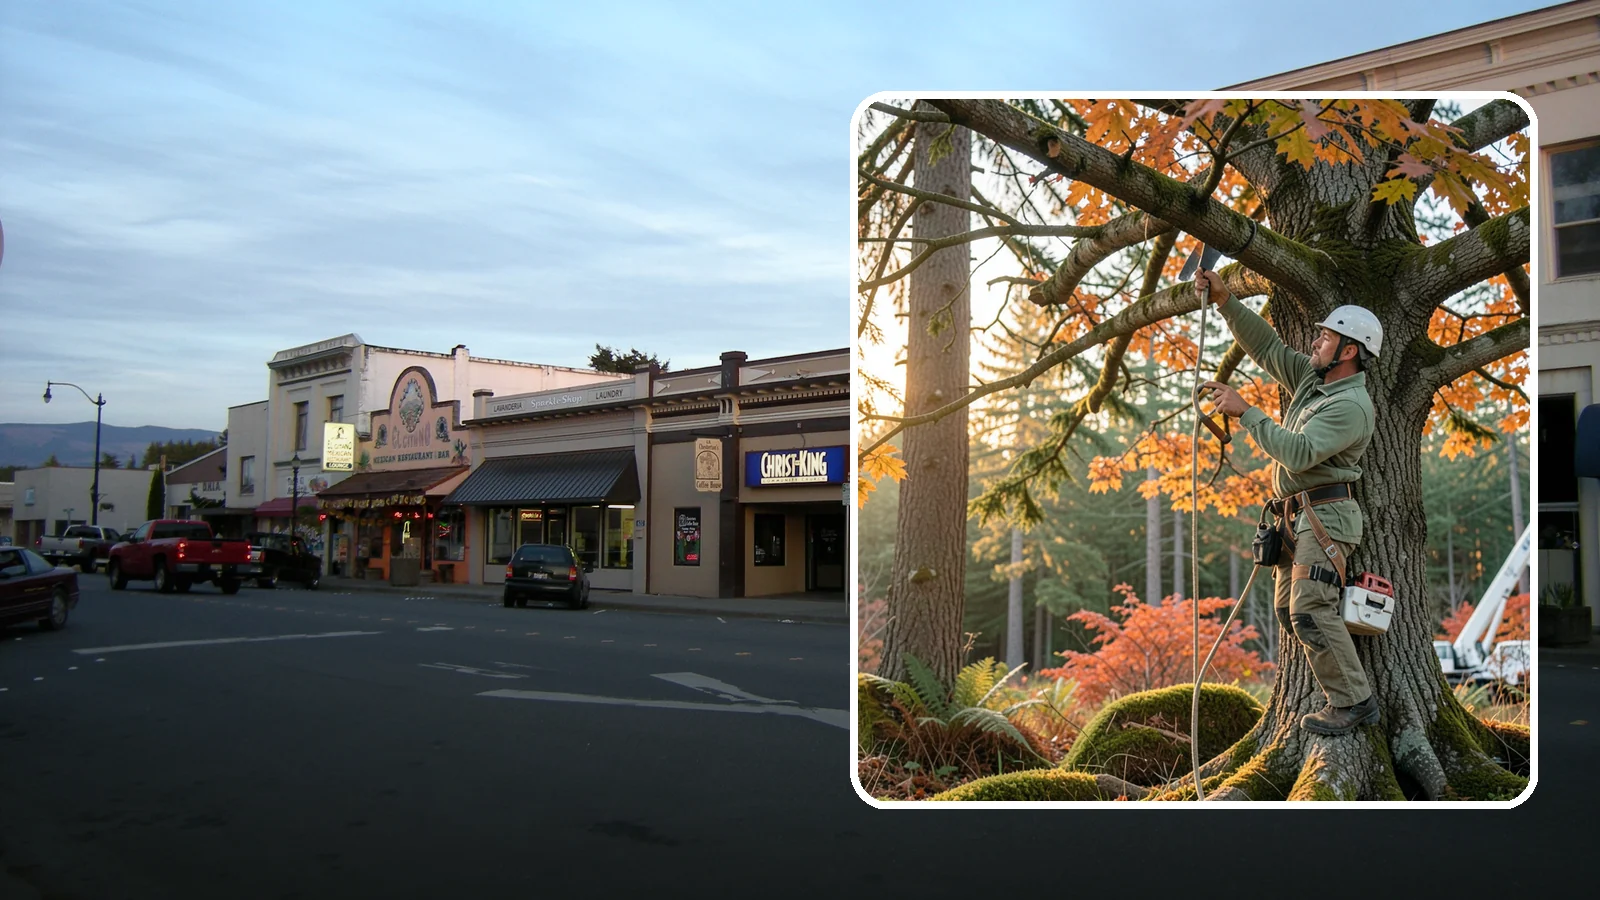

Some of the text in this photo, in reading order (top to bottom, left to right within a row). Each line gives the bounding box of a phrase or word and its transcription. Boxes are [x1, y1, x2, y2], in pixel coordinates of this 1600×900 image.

[562, 394, 583, 405] Shop
[595, 389, 623, 400] LAUNDRY
[494, 402, 522, 413] LAVANDERIA
[373, 450, 449, 464] MEXICAN RESTAURANT BAR
[761, 450, 827, 477] CHRIST KING
